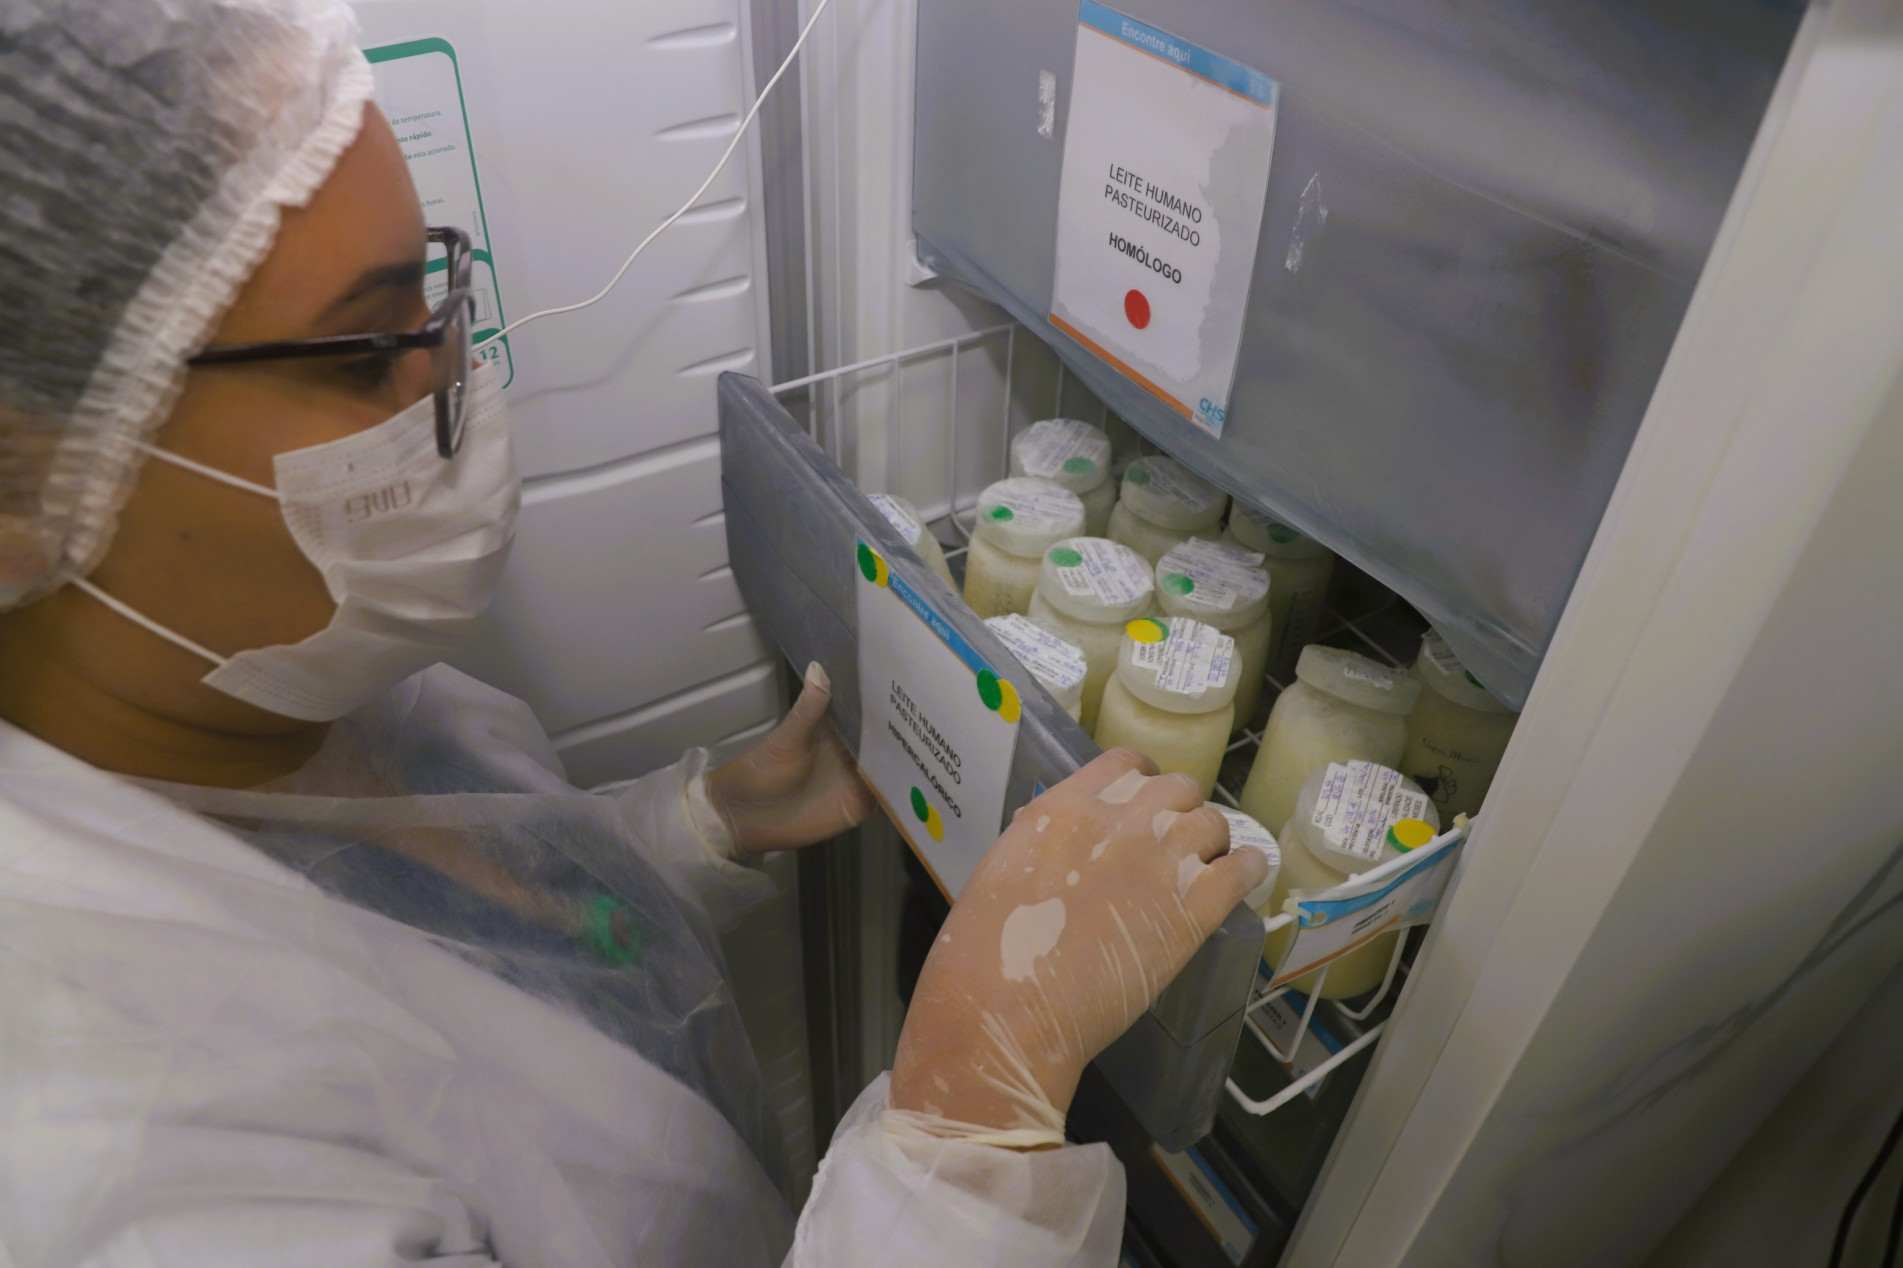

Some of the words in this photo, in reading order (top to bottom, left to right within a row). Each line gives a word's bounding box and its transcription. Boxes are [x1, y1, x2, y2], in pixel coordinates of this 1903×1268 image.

[1121, 19, 1165, 52] Encontre
[1167, 45, 1191, 65] aqui
[1104, 184, 1200, 247] PASTEURIZADO
[1109, 163, 1143, 193] LEITE
[1145, 182, 1202, 224] HUMANO
[1108, 231, 1182, 285] HOMÓLOGO
[889, 693, 961, 785] PASTEURIZADO
[892, 679, 917, 713] LEITE
[918, 711, 961, 768] HUMANO
